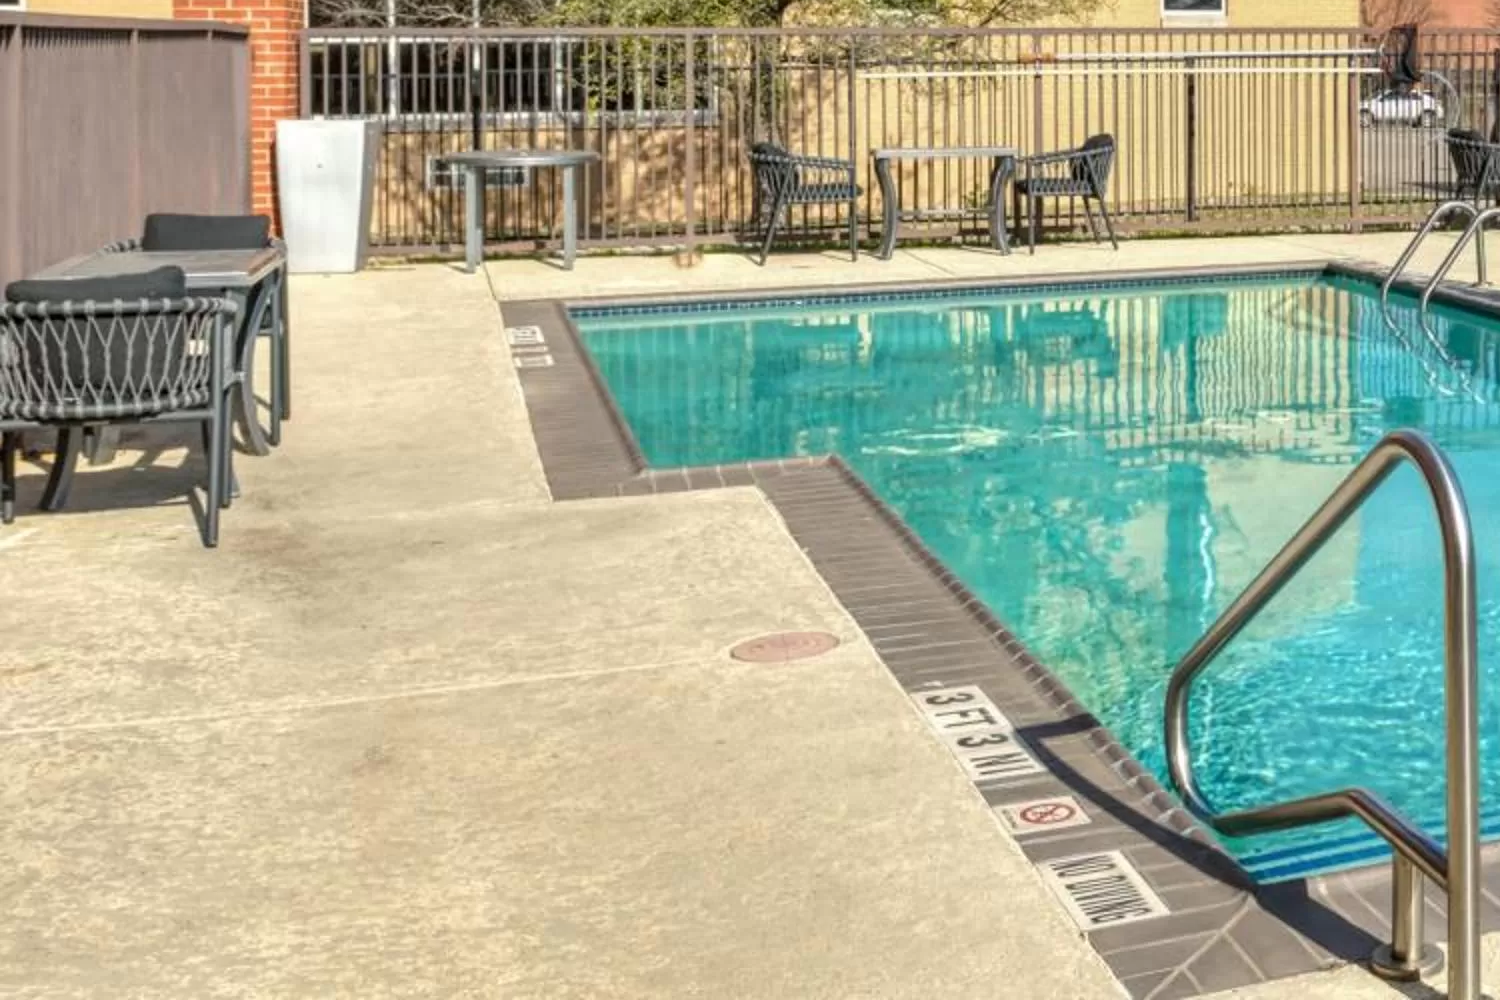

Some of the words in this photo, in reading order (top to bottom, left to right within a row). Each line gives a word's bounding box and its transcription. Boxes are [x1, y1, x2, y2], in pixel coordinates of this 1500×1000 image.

[925, 692, 975, 705] 3
[934, 707, 998, 728] FT
[956, 733, 1009, 748] 3
[1048, 854, 1117, 878] NO
[1064, 875, 1153, 924] DIVING
